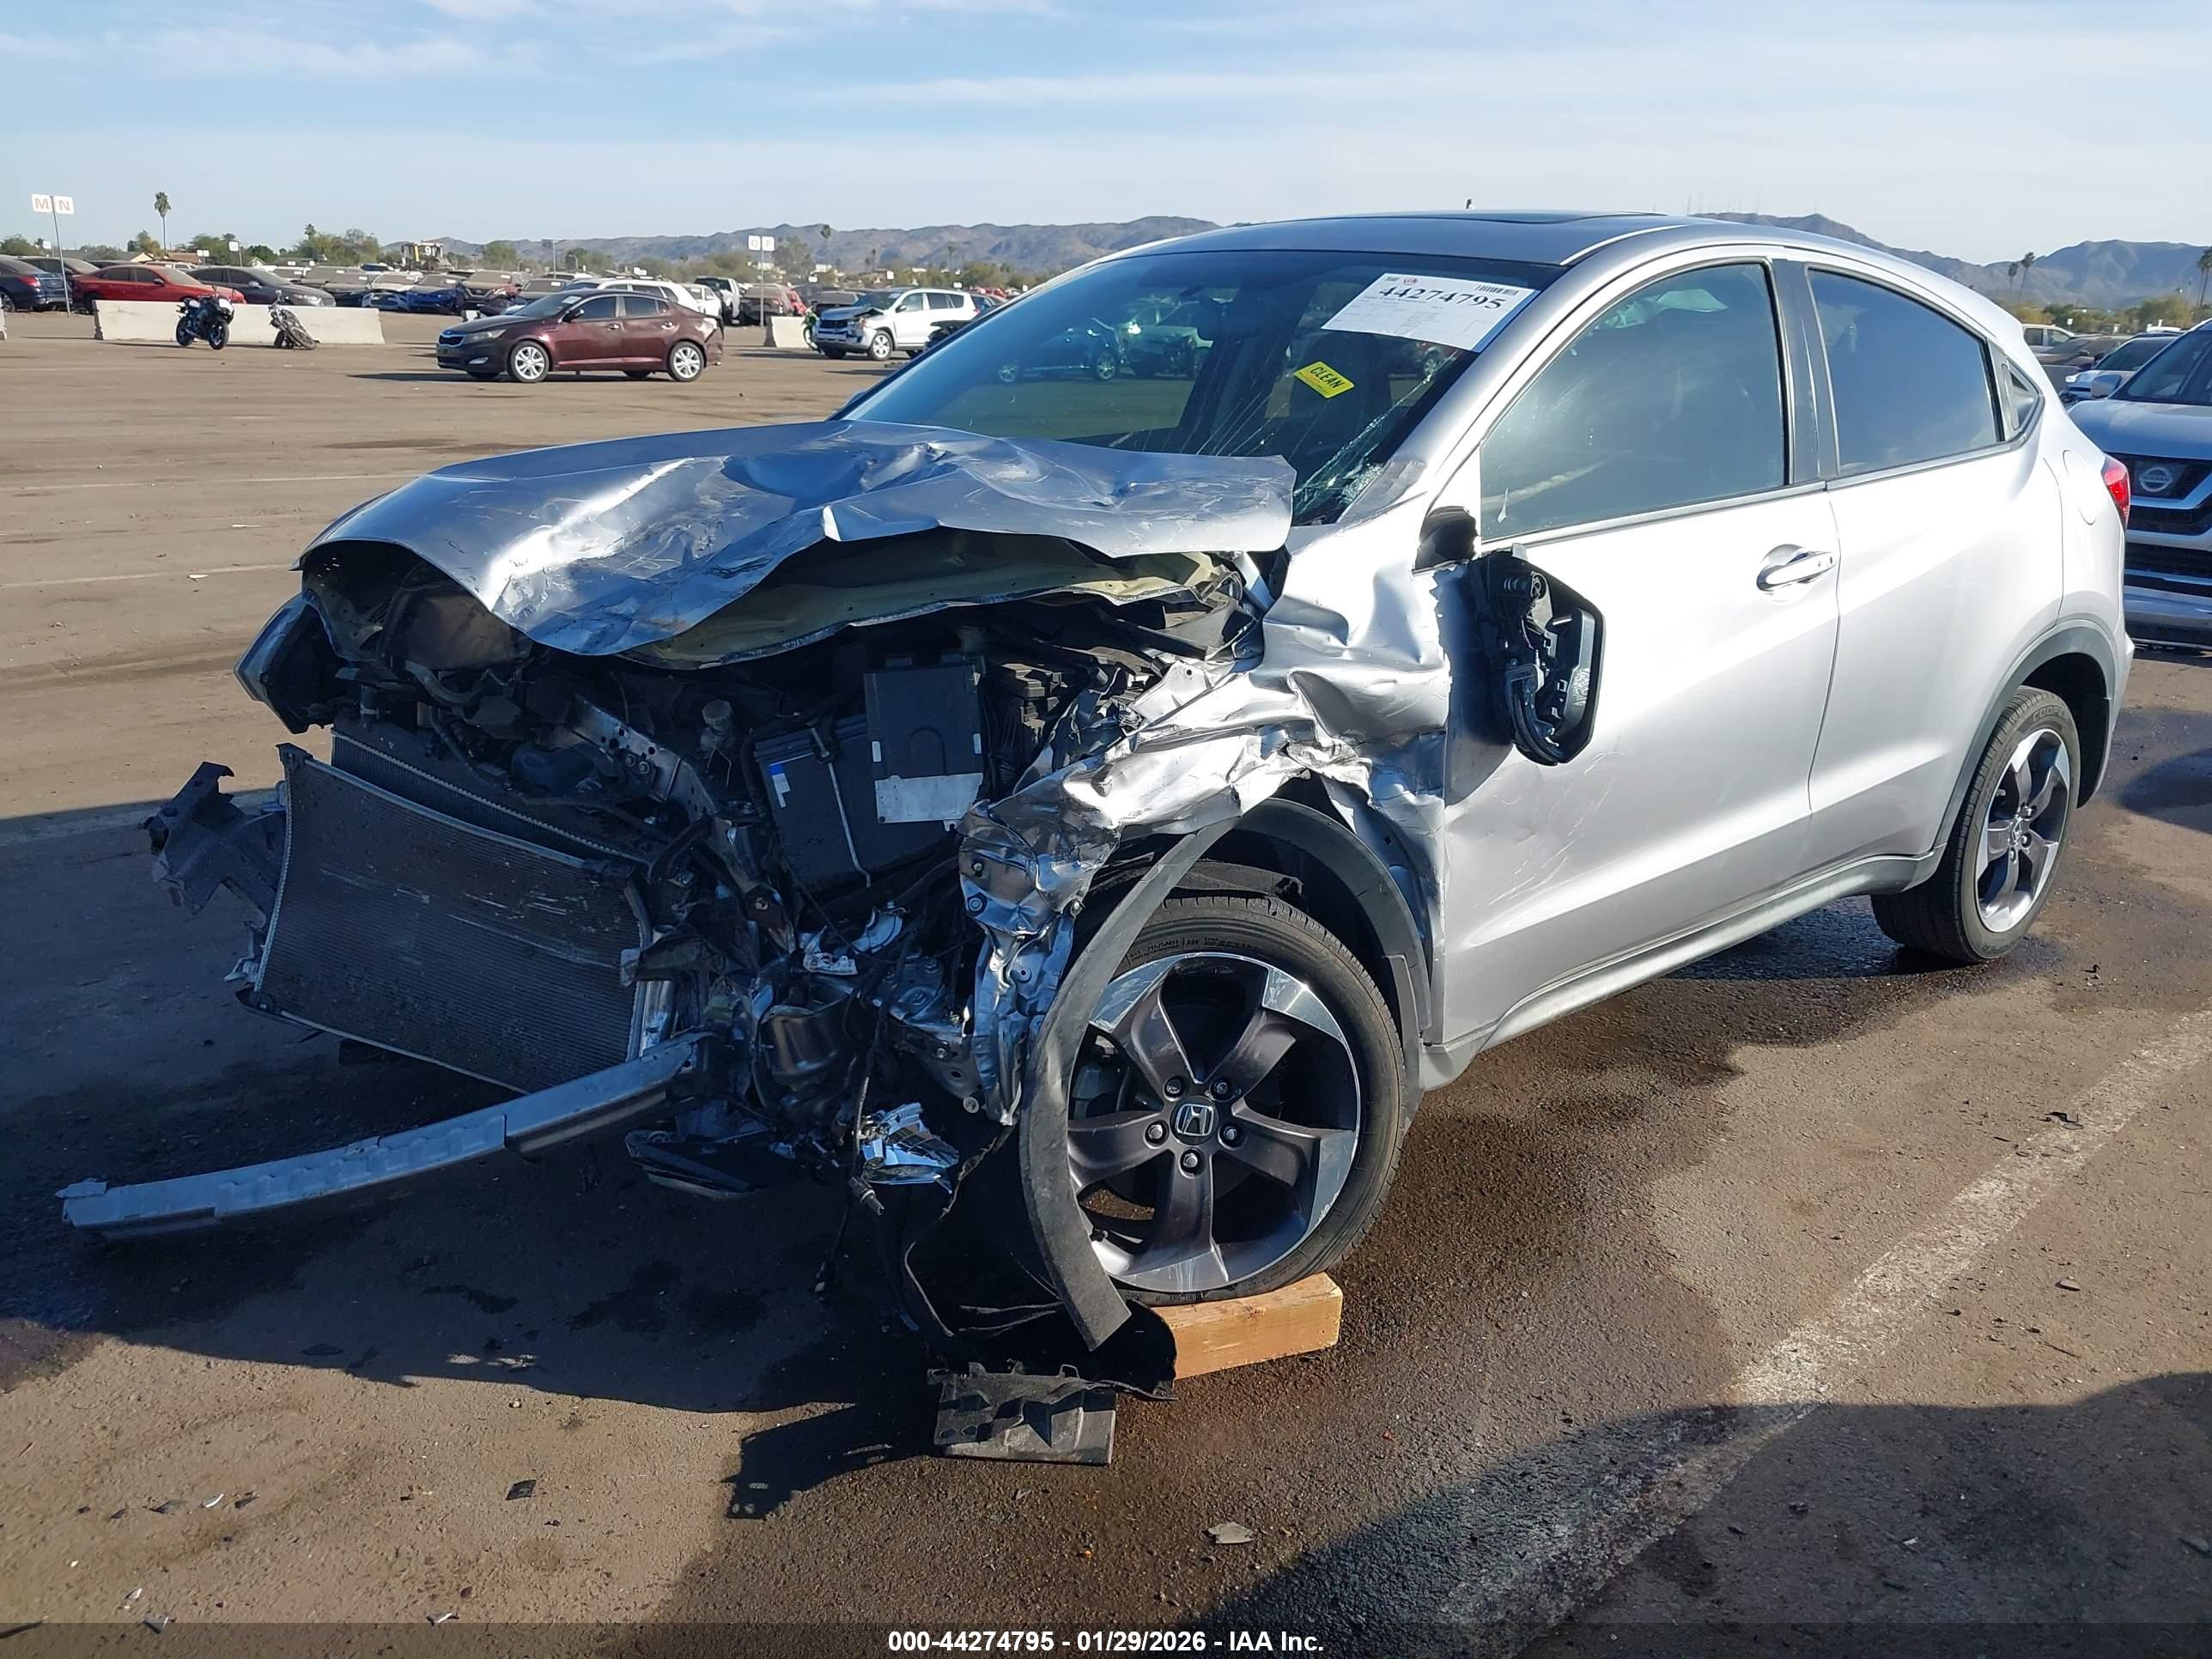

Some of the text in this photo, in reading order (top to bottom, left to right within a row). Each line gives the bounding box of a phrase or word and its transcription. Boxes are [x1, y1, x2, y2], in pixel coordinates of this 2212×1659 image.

[34, 198, 49, 210] M
[59, 199, 70, 211] N
[1378, 286, 1507, 309] 44274795
[1310, 367, 1345, 388] CLEAN
